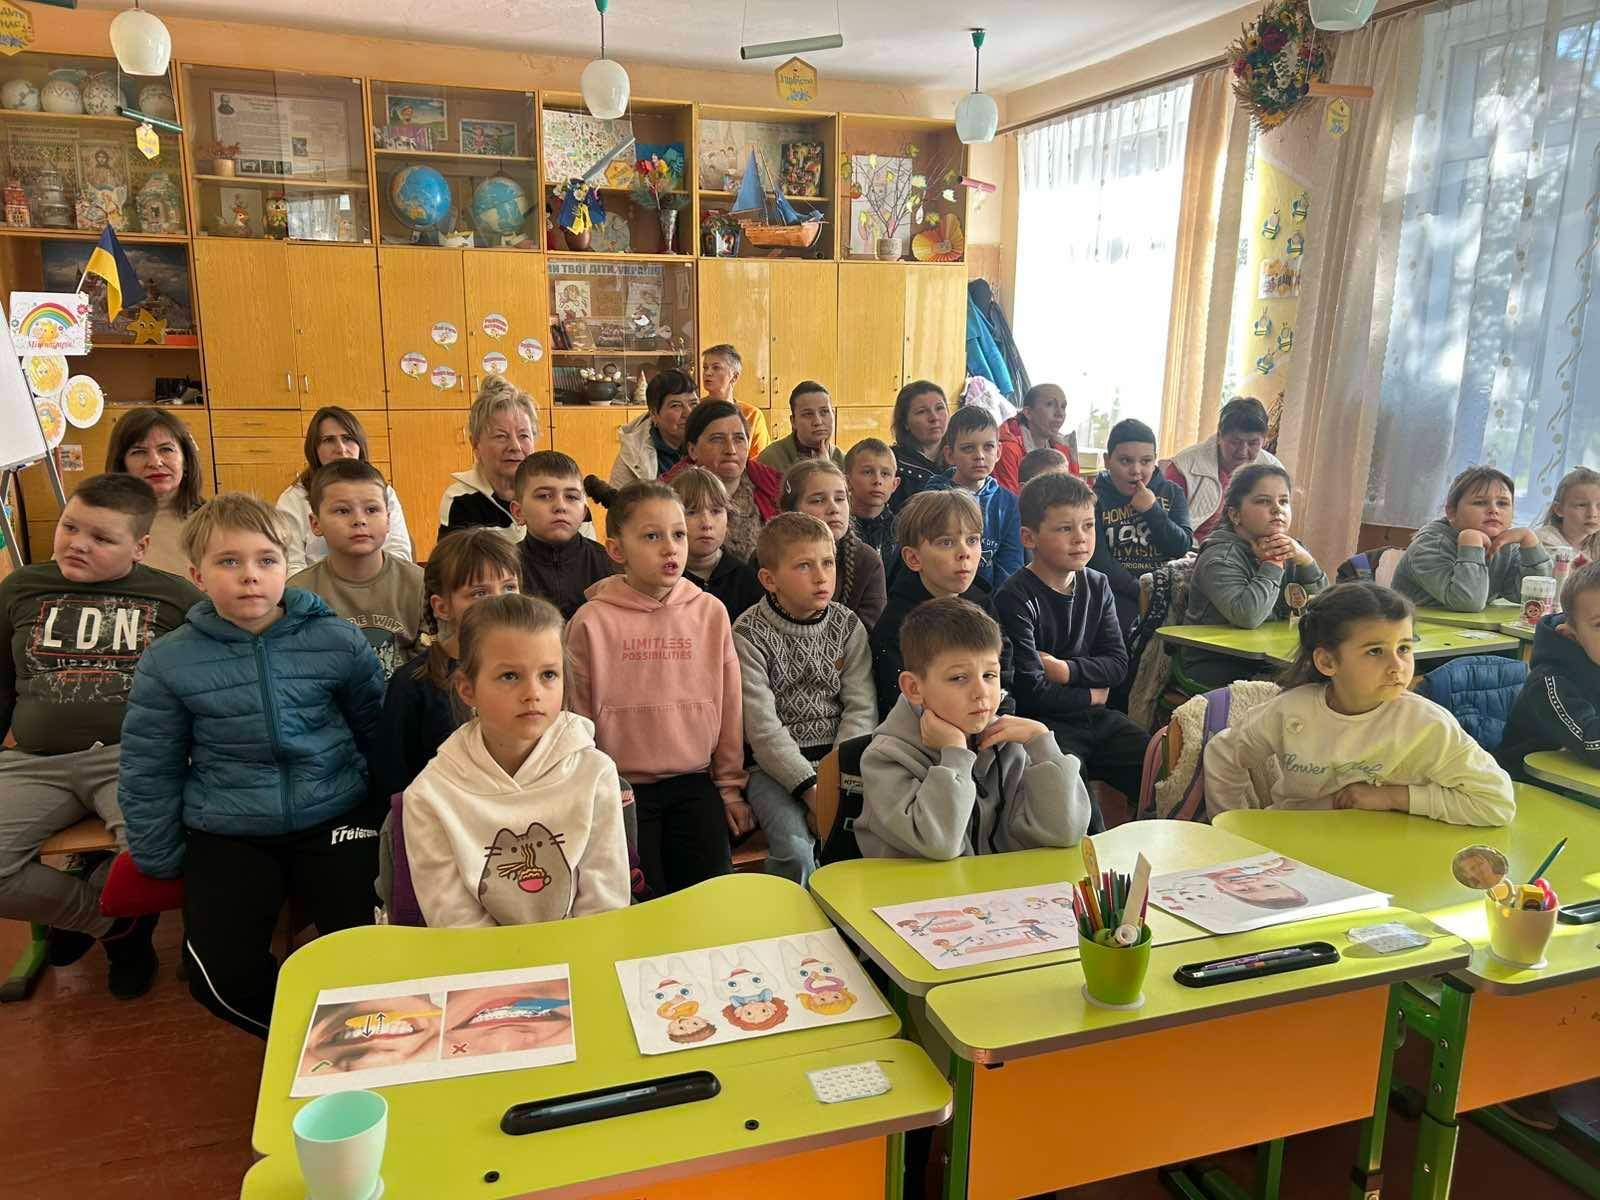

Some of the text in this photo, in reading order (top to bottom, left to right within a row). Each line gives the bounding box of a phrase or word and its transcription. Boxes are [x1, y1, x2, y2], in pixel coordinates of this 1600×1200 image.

[562, 263, 586, 274] ТВОЇ
[372, 614, 408, 633] WIT
[623, 638, 692, 650] LIMITLESS
[622, 650, 692, 661] POSSIBILITIES
